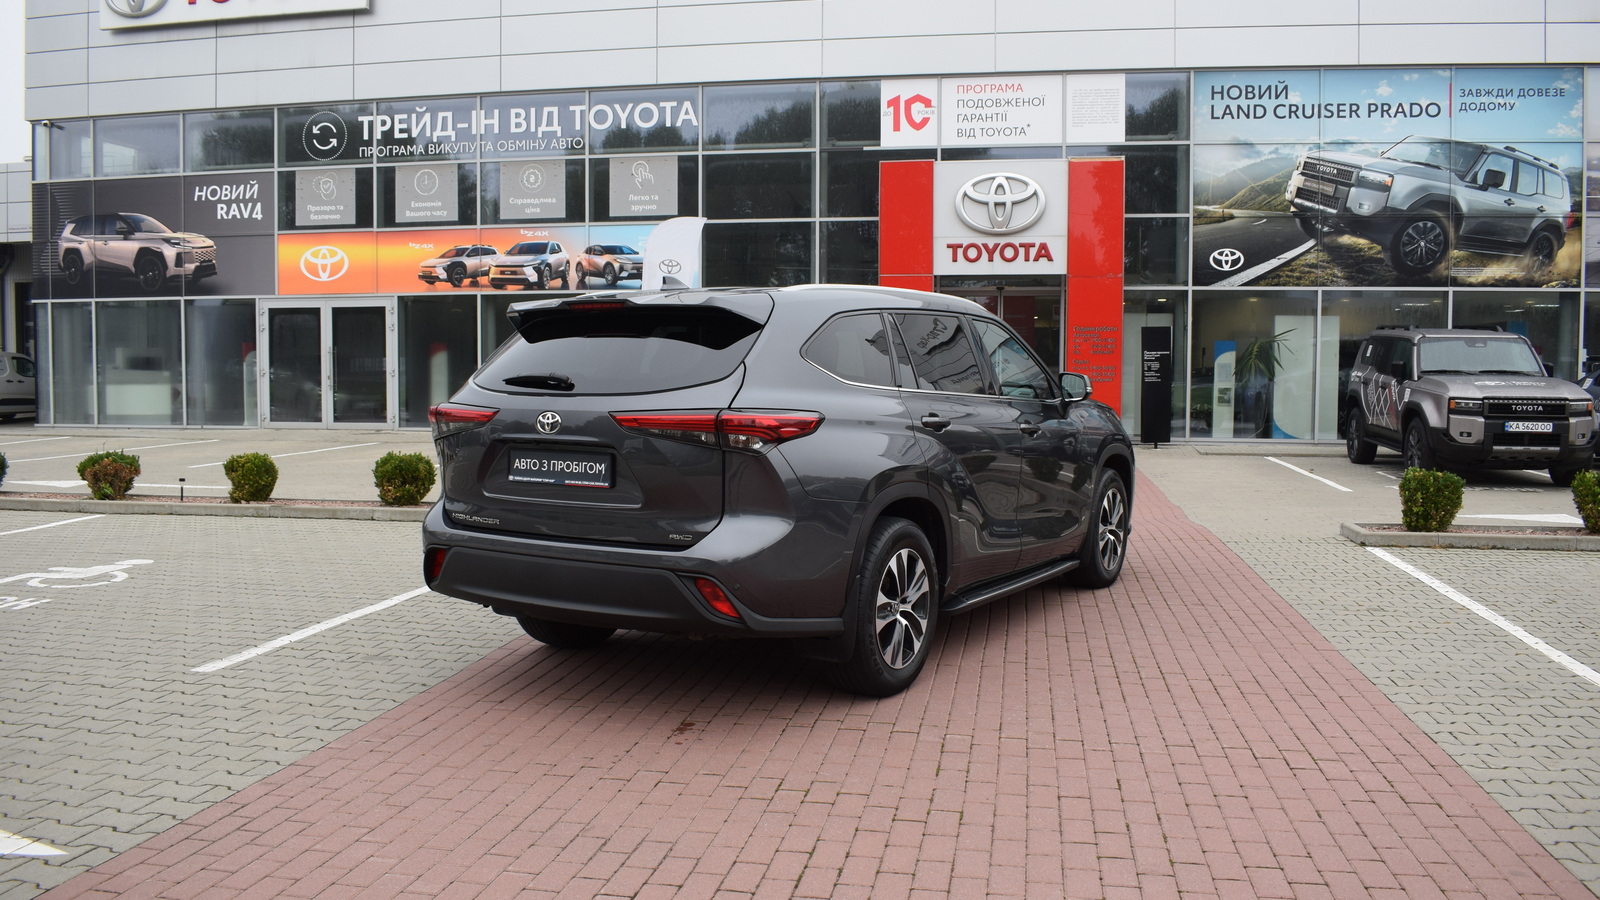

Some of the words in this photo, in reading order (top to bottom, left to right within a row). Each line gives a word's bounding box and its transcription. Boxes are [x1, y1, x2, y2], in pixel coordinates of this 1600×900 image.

[956, 83, 1024, 94] ПРОГРАМА
[1211, 80, 1289, 100] НОВИЙ
[1459, 88, 1514, 99] ЗАВЖДИ
[1517, 87, 1566, 99] ДОВЕЗЕ
[956, 94, 1046, 110] ПОДОВЖЕНОЇ
[1459, 101, 1516, 113] ДОДОМУ
[956, 110, 1008, 123] ГАРАНТІЇ
[1211, 104, 1267, 120] LAND
[1273, 102, 1361, 119] CRUISER
[1367, 102, 1441, 118] PRADO
[358, 106, 499, 142] ТРЕЙД-ІН
[510, 106, 562, 137] ВІД
[569, 101, 698, 130] TOYOTA
[956, 128, 976, 139] ВІД
[359, 144, 425, 157] ПРОГРАМА
[428, 142, 477, 155] ВИКУПУ
[481, 141, 494, 152] ТА
[497, 139, 547, 151] ОБМІНУ
[550, 137, 584, 149] АВТО
[1316, 165, 1337, 174] TOYOTA
[194, 180, 259, 201] НОВИЙ
[411, 200, 442, 208] Економія
[509, 197, 556, 205] Справедлива
[629, 194, 650, 202] Легко
[217, 202, 263, 220] RAV4
[307, 204, 336, 213] Прозоро
[432, 209, 448, 217] часу
[631, 204, 657, 212] зручно
[310, 213, 340, 221] безпечно
[946, 242, 1054, 263] TOYOTA
[1522, 423, 1539, 431] 5620
[513, 458, 539, 470] АВТО
[550, 460, 605, 474] ПРОБІГОМ
[452, 512, 500, 524] HIGHLANDER
